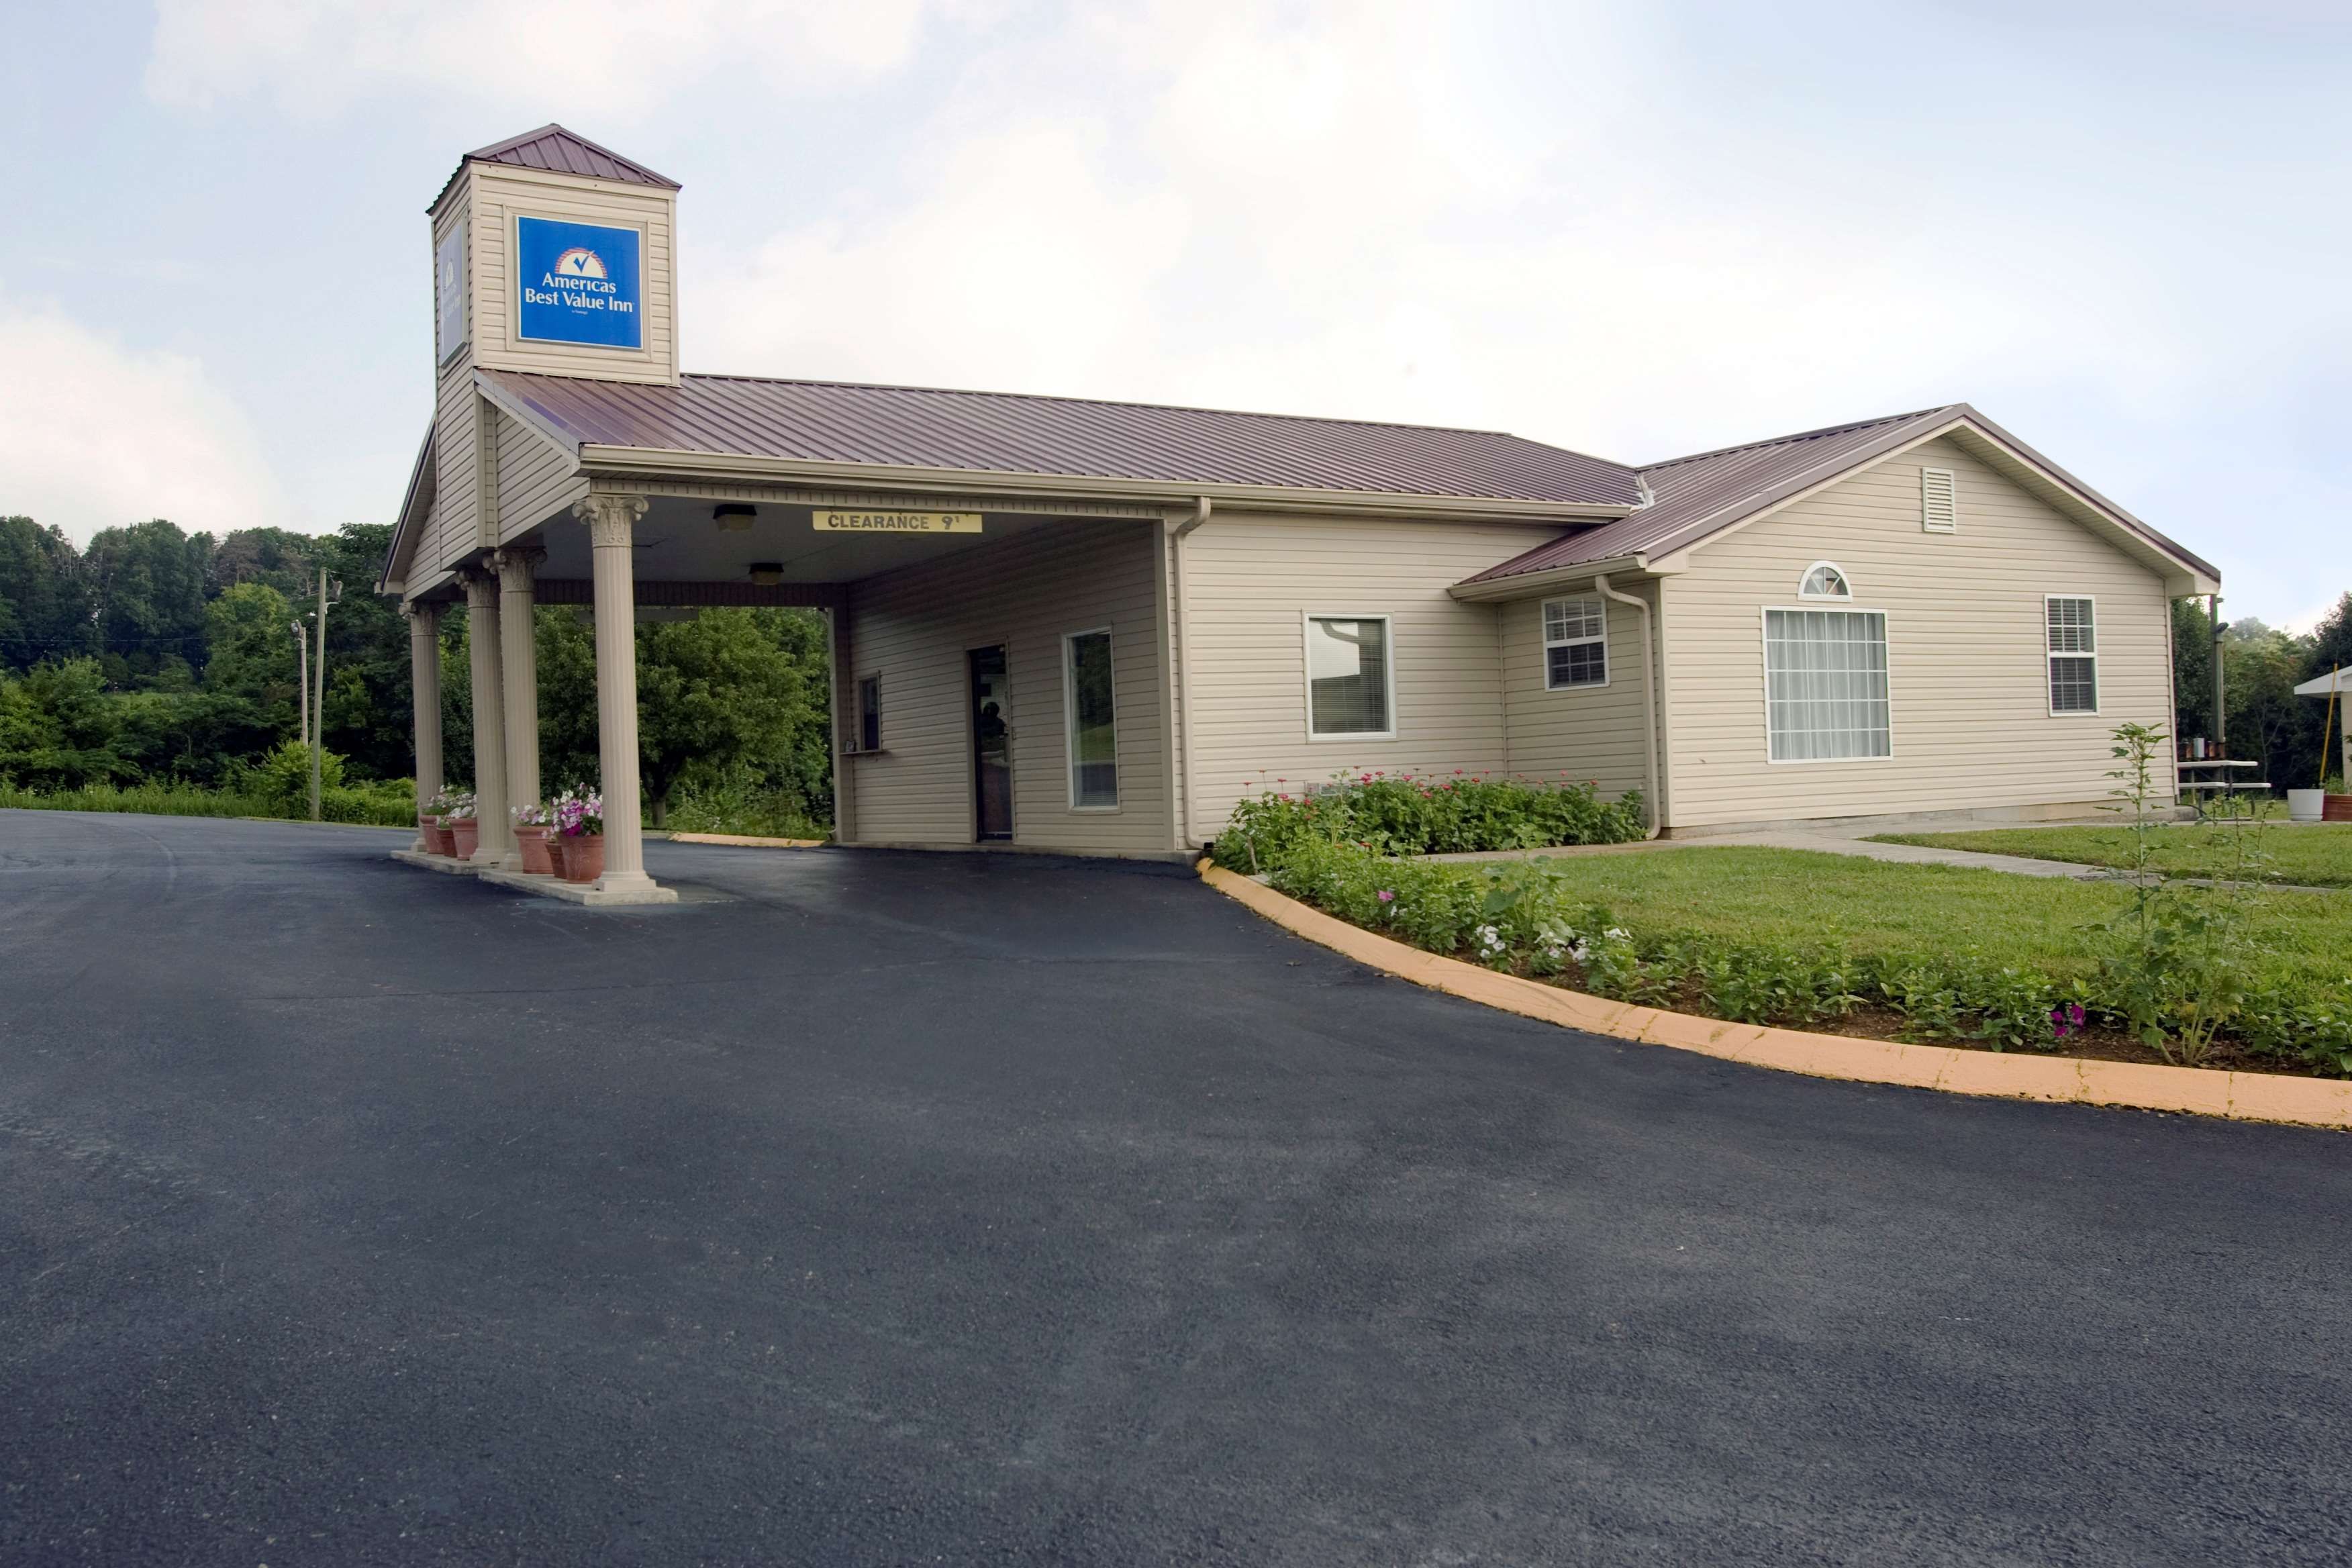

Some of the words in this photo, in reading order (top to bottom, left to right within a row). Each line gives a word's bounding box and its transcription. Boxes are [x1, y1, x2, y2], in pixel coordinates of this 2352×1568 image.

[542, 272, 617, 294] Americas
[525, 288, 559, 305] Best
[562, 291, 605, 309] Value
[609, 296, 634, 313] Inn
[828, 514, 930, 530] CLEARANCE
